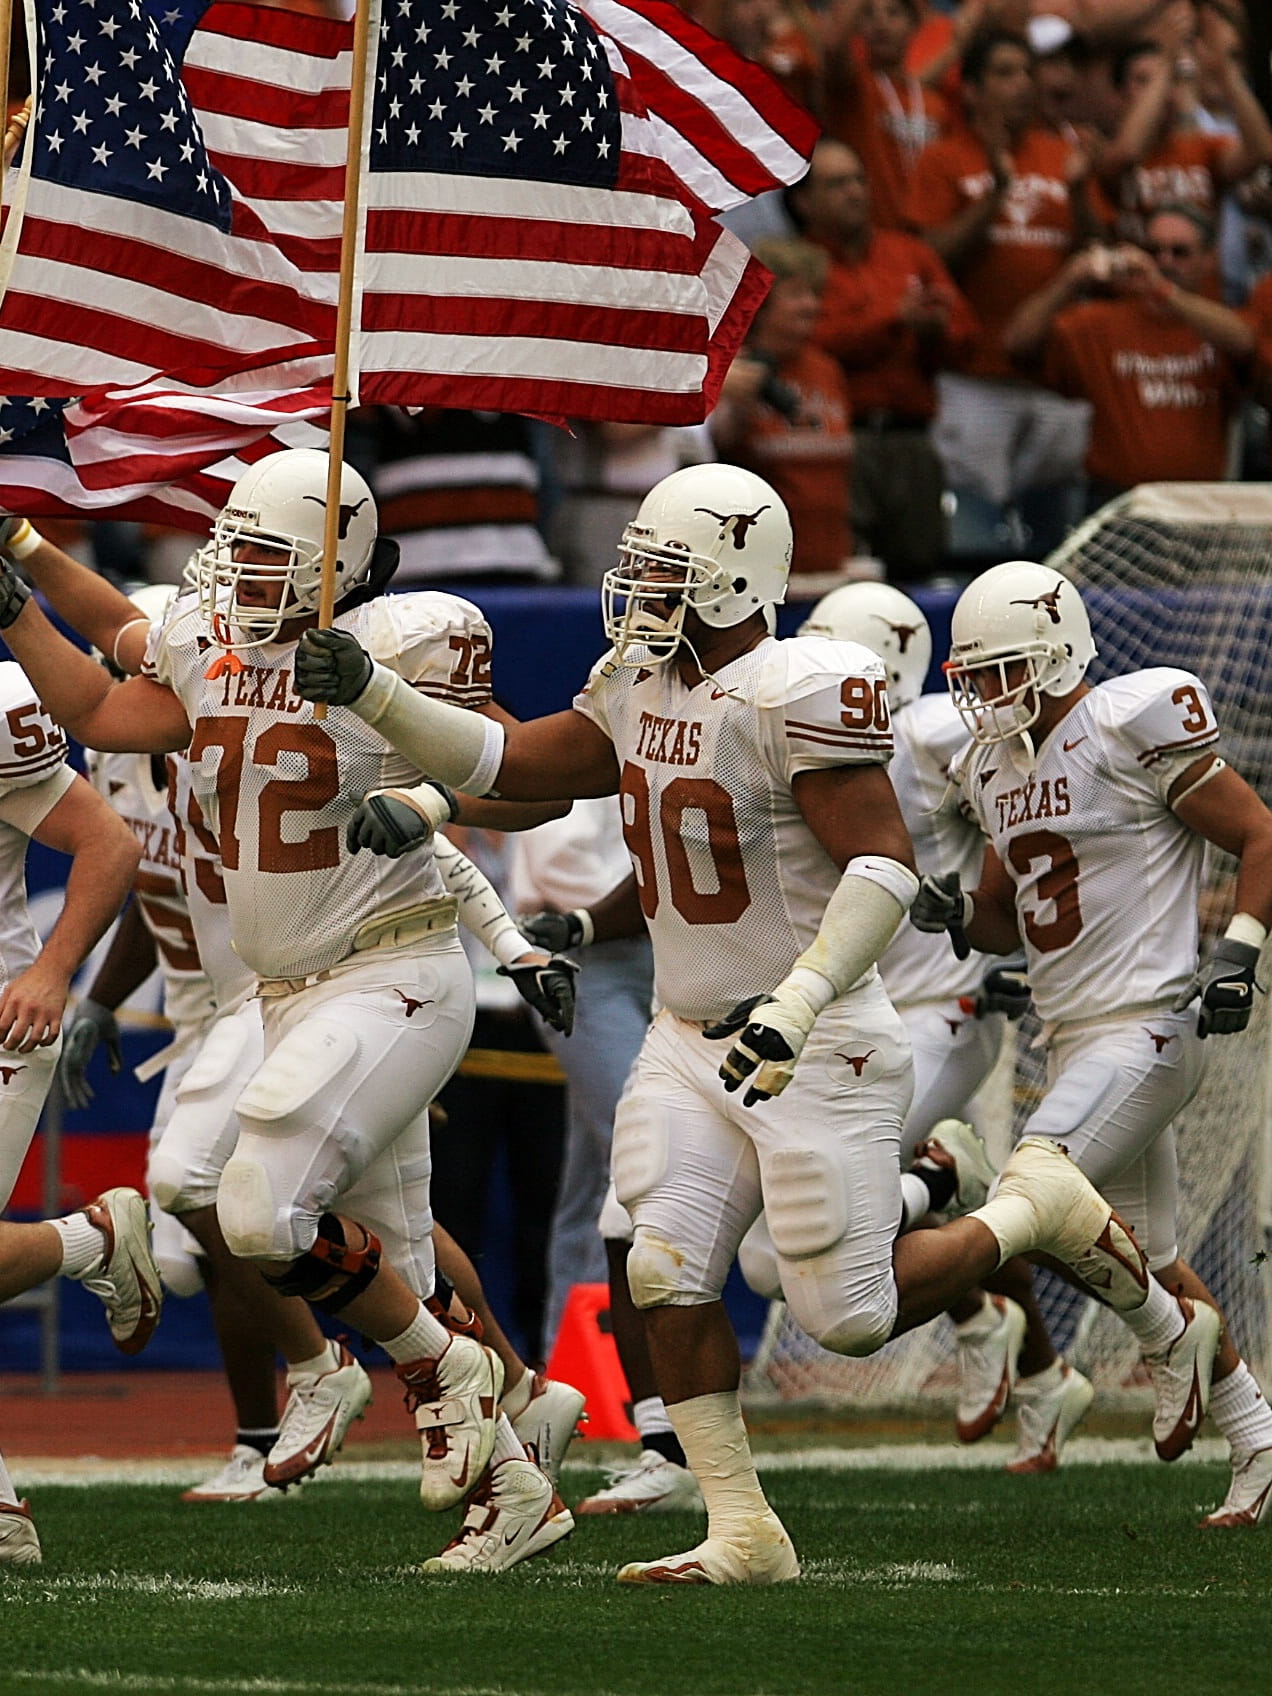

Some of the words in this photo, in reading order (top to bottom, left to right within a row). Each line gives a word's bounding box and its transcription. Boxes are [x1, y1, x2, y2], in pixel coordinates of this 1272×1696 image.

[448, 634, 492, 684] 72
[840, 677, 890, 731] 90
[1171, 685, 1207, 733] 3
[635, 711, 702, 766] TEXAS
[189, 716, 340, 874] 72
[995, 776, 1071, 833] TEXAS
[619, 759, 752, 925] 90
[1007, 829, 1083, 954] 3
